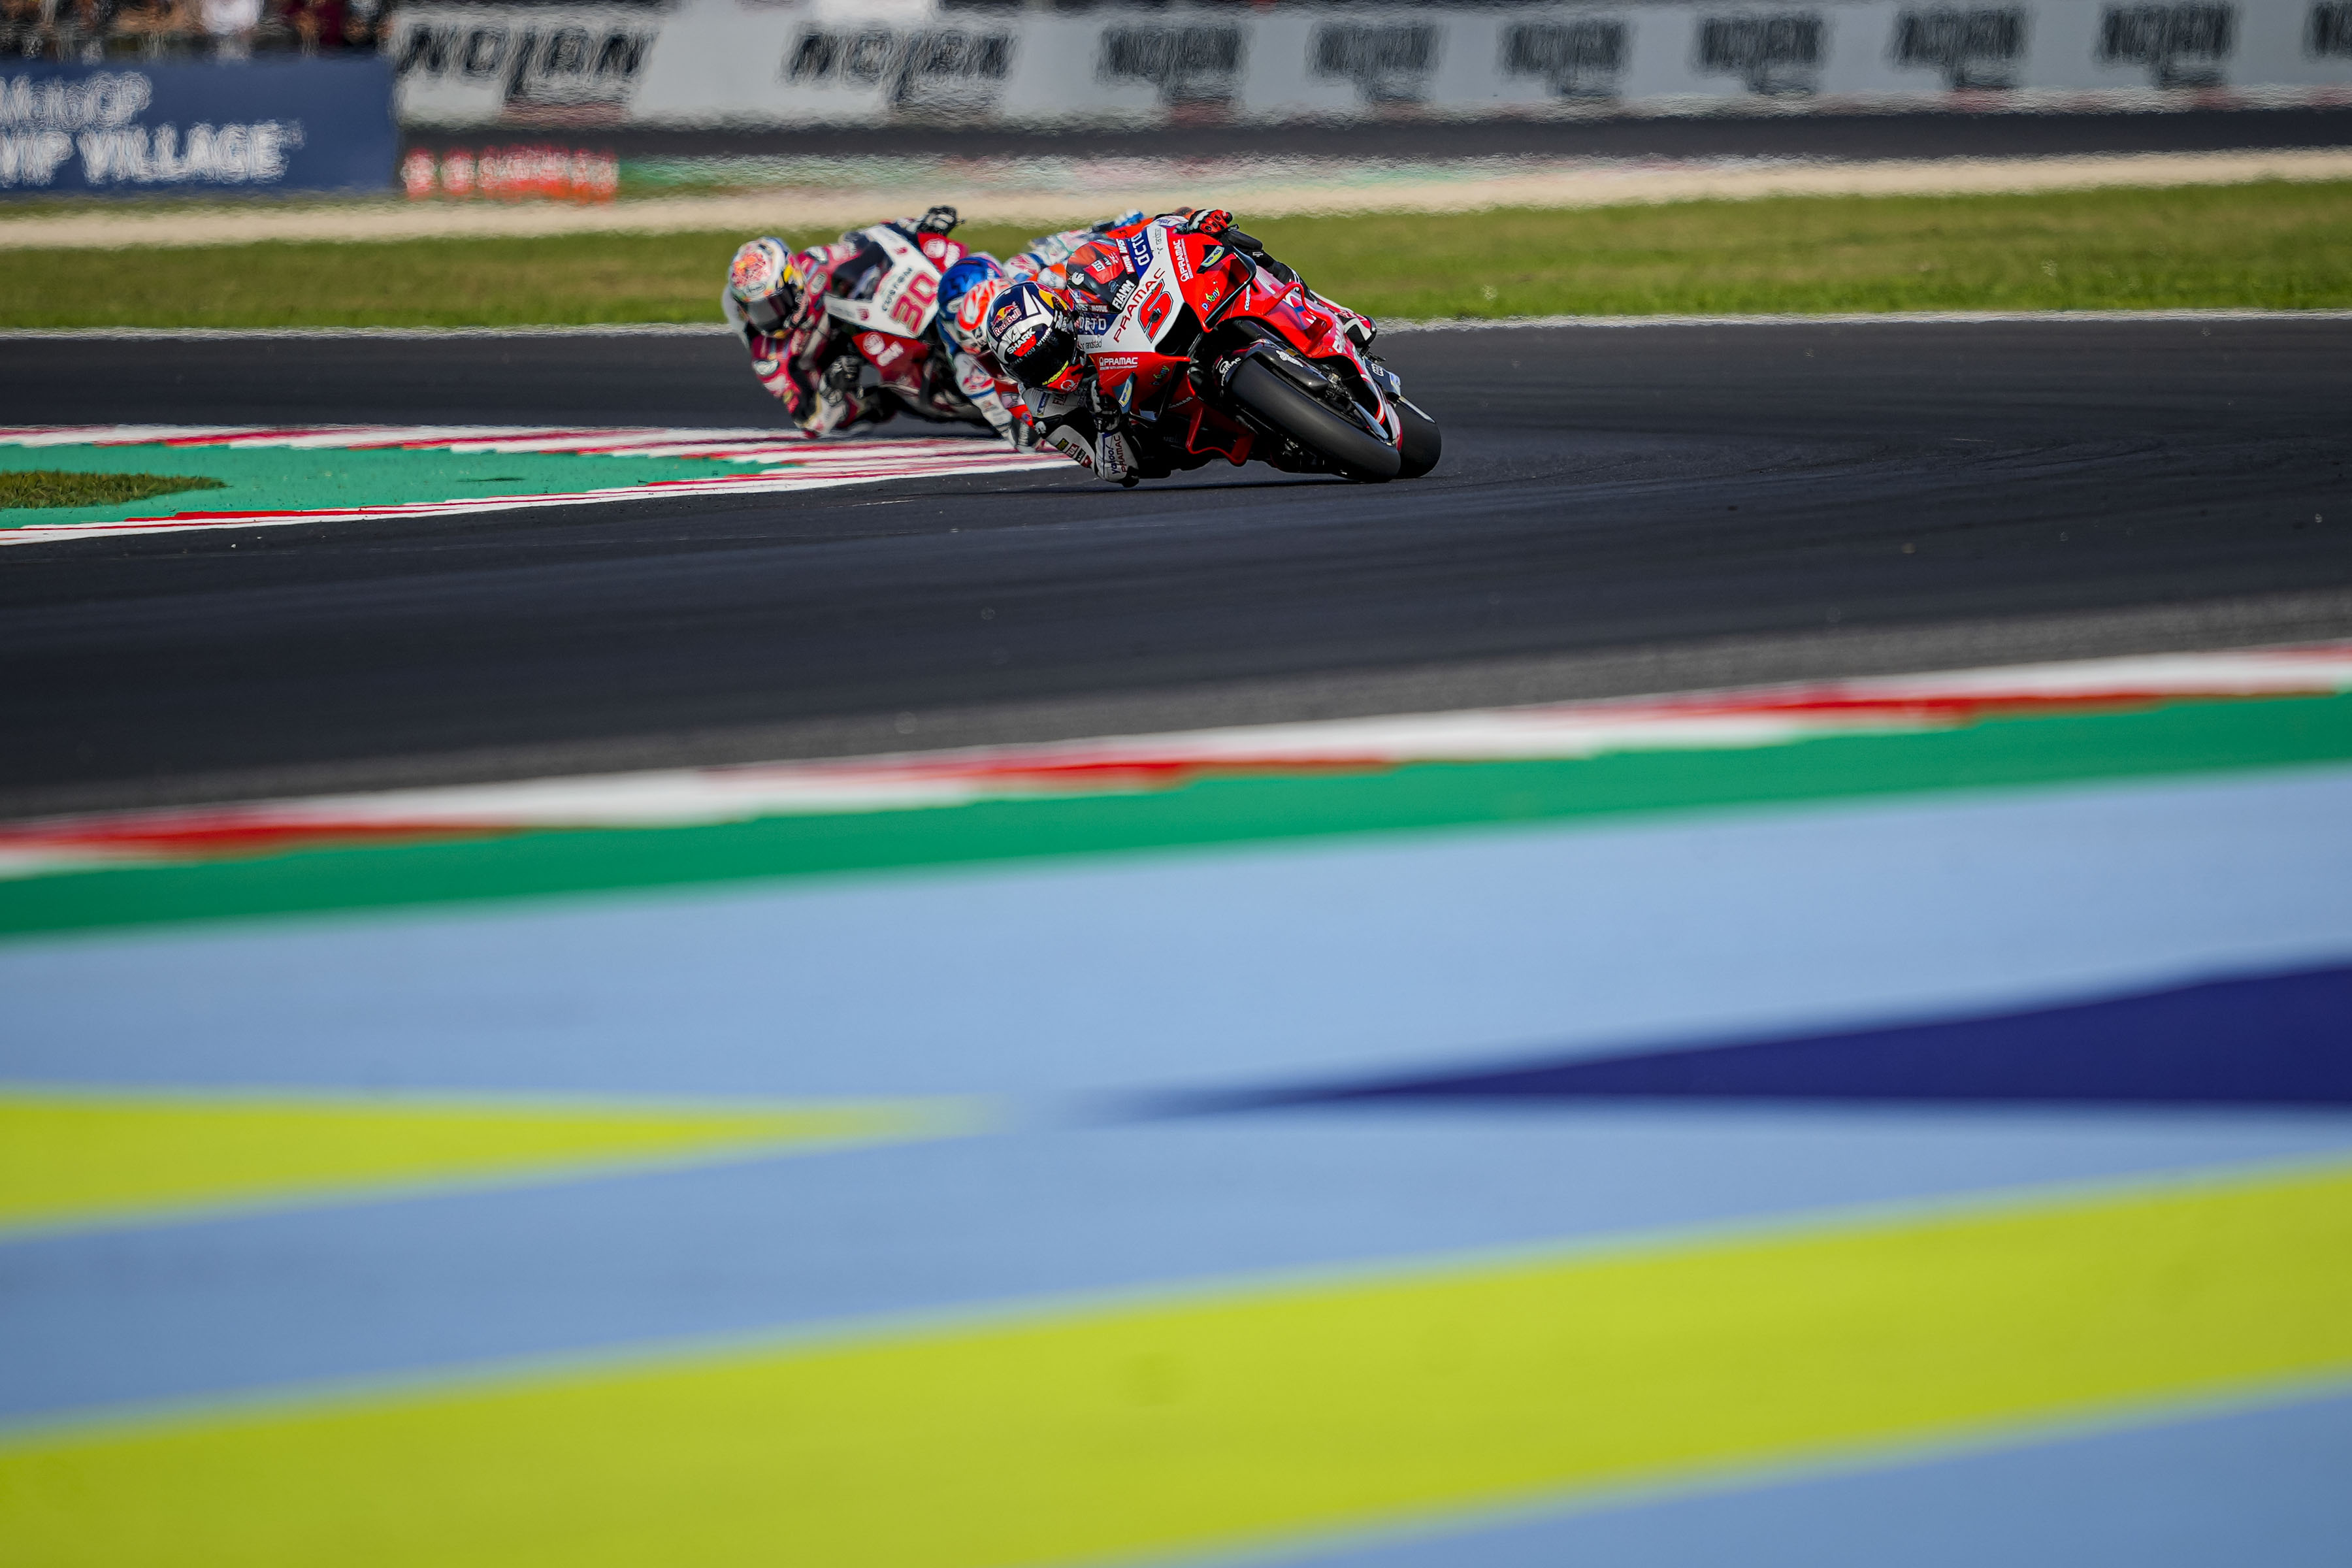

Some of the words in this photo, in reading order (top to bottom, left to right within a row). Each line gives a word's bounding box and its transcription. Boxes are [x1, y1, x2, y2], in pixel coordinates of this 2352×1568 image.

[76, 122, 289, 186] VILLAGE
[1173, 239, 1189, 276] PRAMAC
[890, 271, 938, 336] 30
[1112, 280, 1135, 310] FIAMM
[1113, 267, 1165, 344] PRAMAC
[1138, 278, 1174, 344] 5
[992, 322, 1008, 338] Red
[1007, 307, 1022, 324] Bull
[1007, 327, 1036, 355] SHARK
[1103, 357, 1139, 365] PRAMAC
[1113, 435, 1128, 473] PRAMAC
